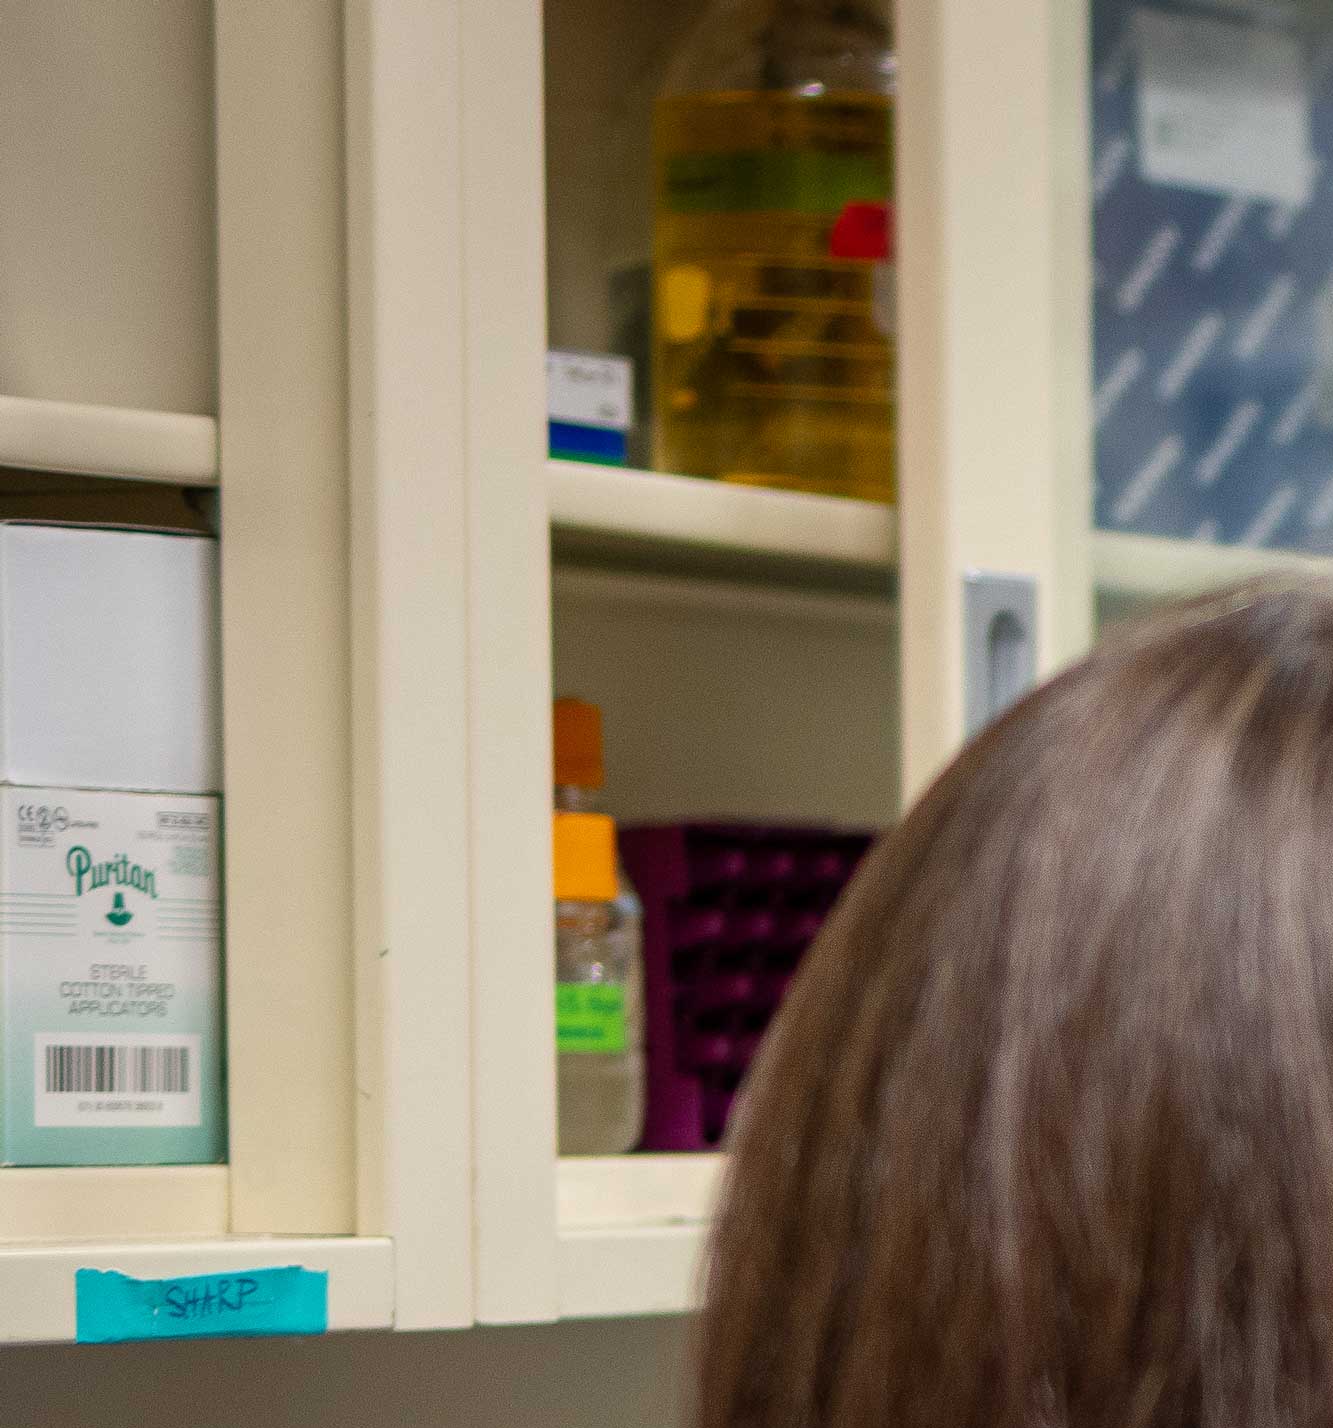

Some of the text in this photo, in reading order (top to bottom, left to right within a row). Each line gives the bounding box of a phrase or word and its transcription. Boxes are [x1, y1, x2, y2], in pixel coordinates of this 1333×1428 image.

[66, 845, 158, 899] Puritan
[90, 964, 148, 979] STERILE
[60, 981, 175, 999] COTTON TIPPED
[68, 1000, 168, 1017] APPLICATORS
[164, 1278, 259, 1319] SHARP
